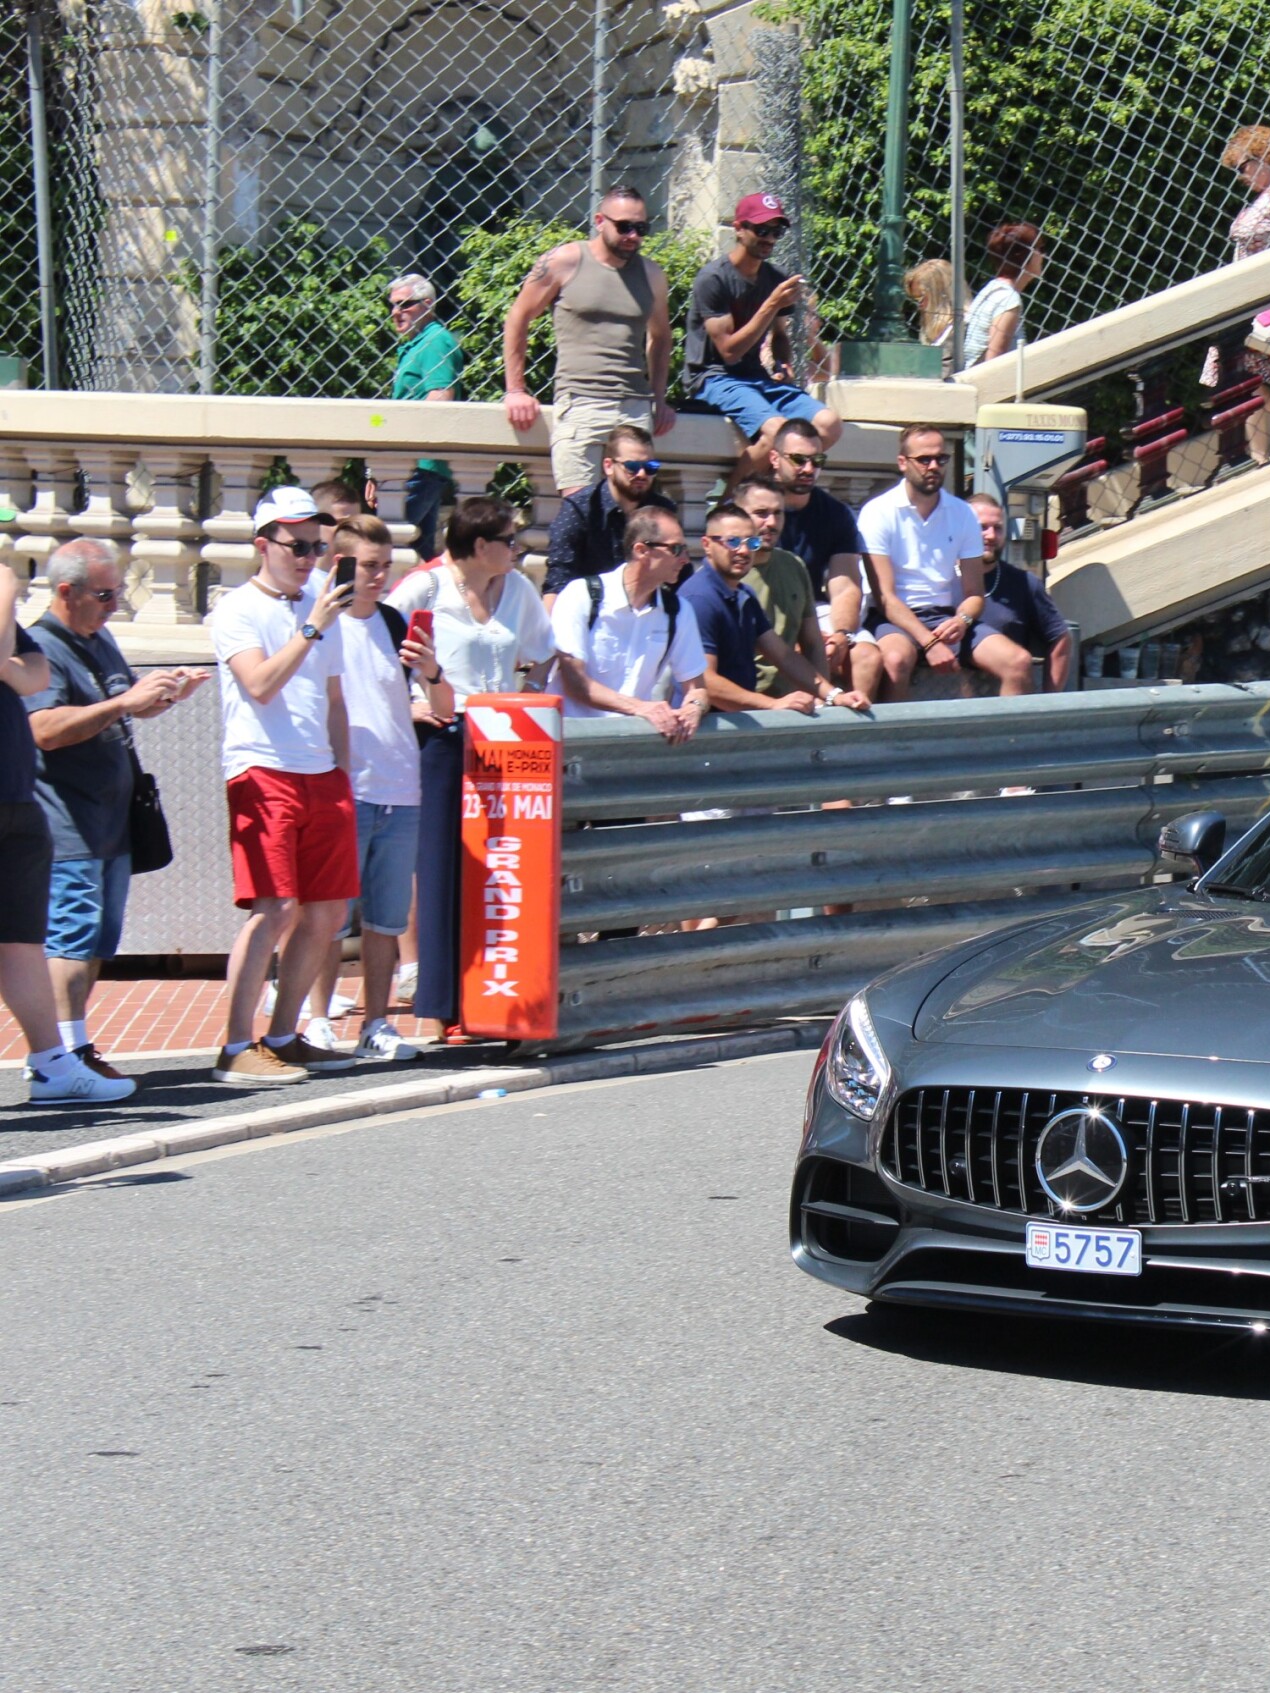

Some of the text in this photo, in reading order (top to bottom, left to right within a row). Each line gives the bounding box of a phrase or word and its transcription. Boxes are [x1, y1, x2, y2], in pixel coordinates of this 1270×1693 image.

[507, 749, 552, 761] MONACO
[507, 761, 551, 773] E-PRIX
[463, 794, 552, 820] 23-26 MAI
[484, 836, 523, 920] GRAND
[482, 929, 520, 997] PRIX
[1034, 1246, 1047, 1256] MC
[1055, 1232, 1134, 1268] 5757
